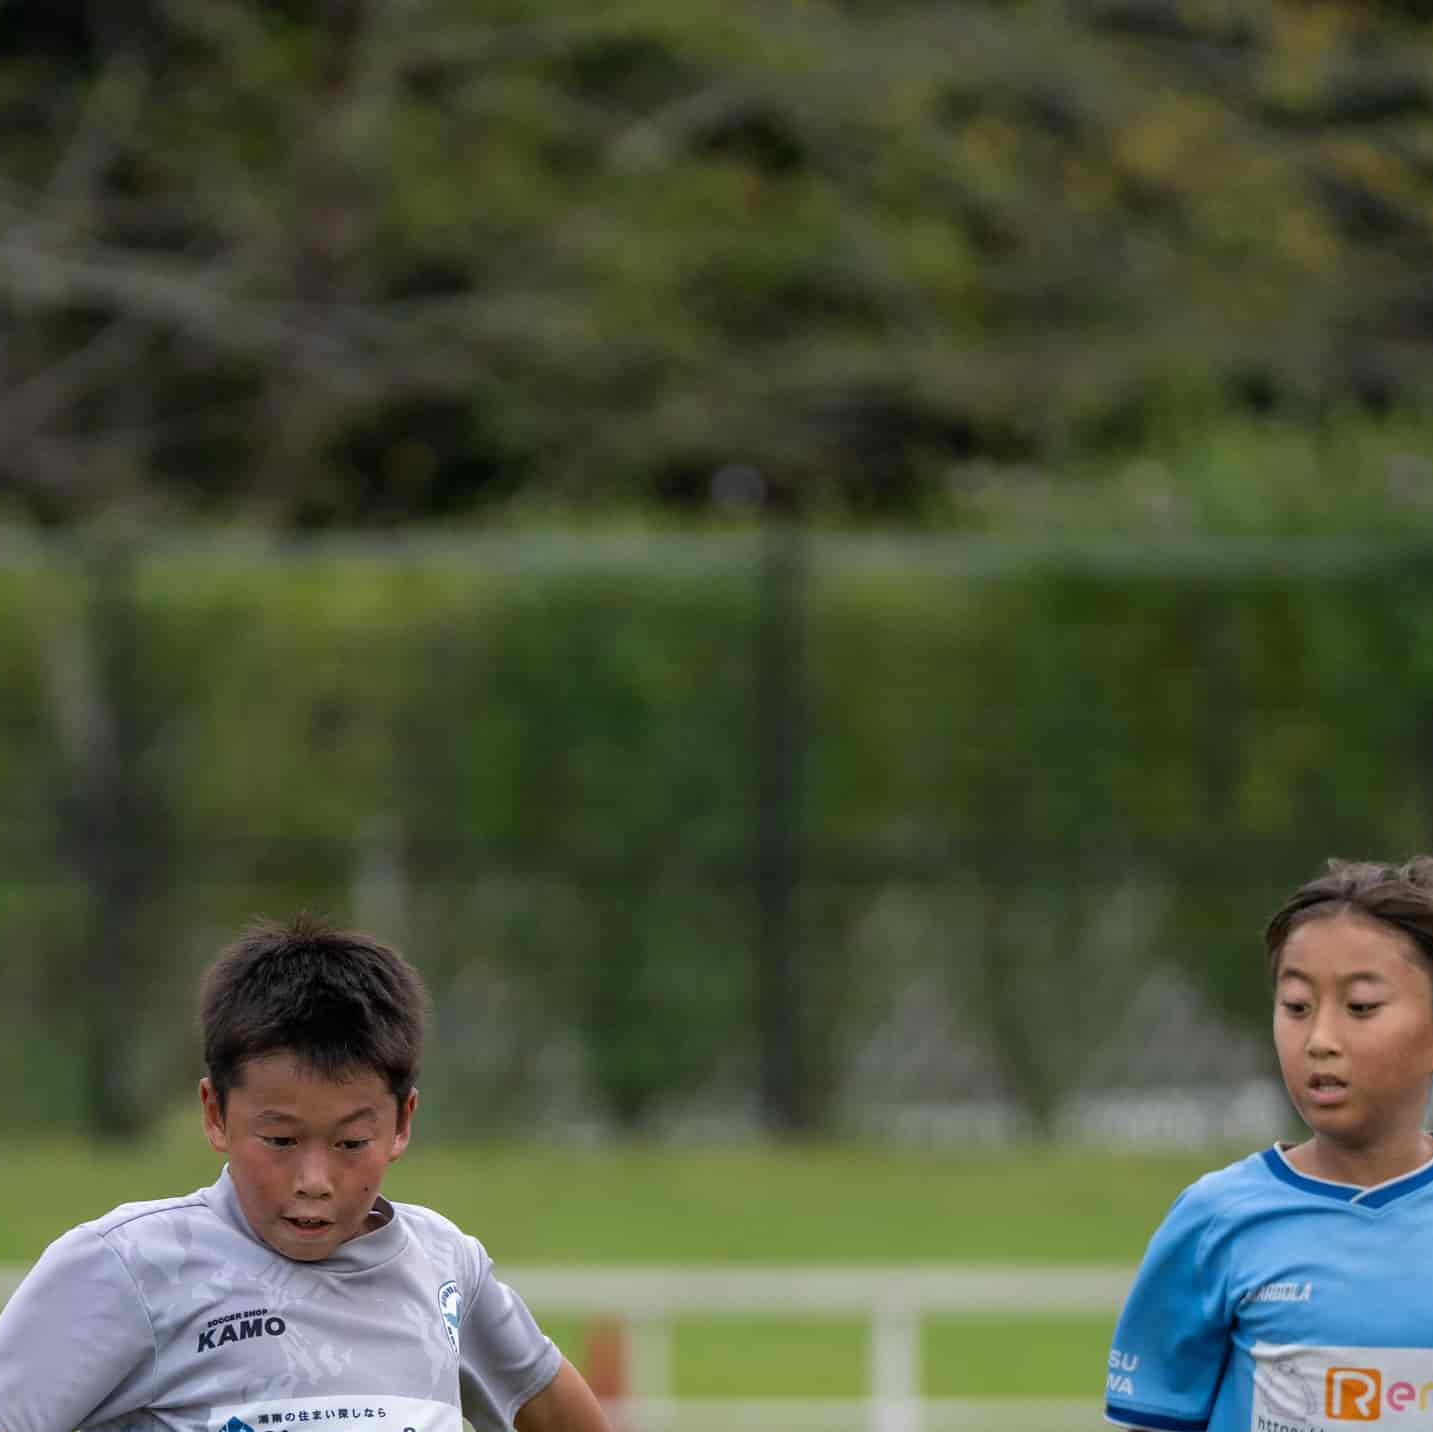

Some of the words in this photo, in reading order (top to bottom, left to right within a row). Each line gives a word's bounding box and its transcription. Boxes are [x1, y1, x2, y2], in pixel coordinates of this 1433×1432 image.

[208, 1313, 242, 1328] SOCCER
[244, 1308, 268, 1318] SHOP
[197, 1316, 286, 1353] KAMO
